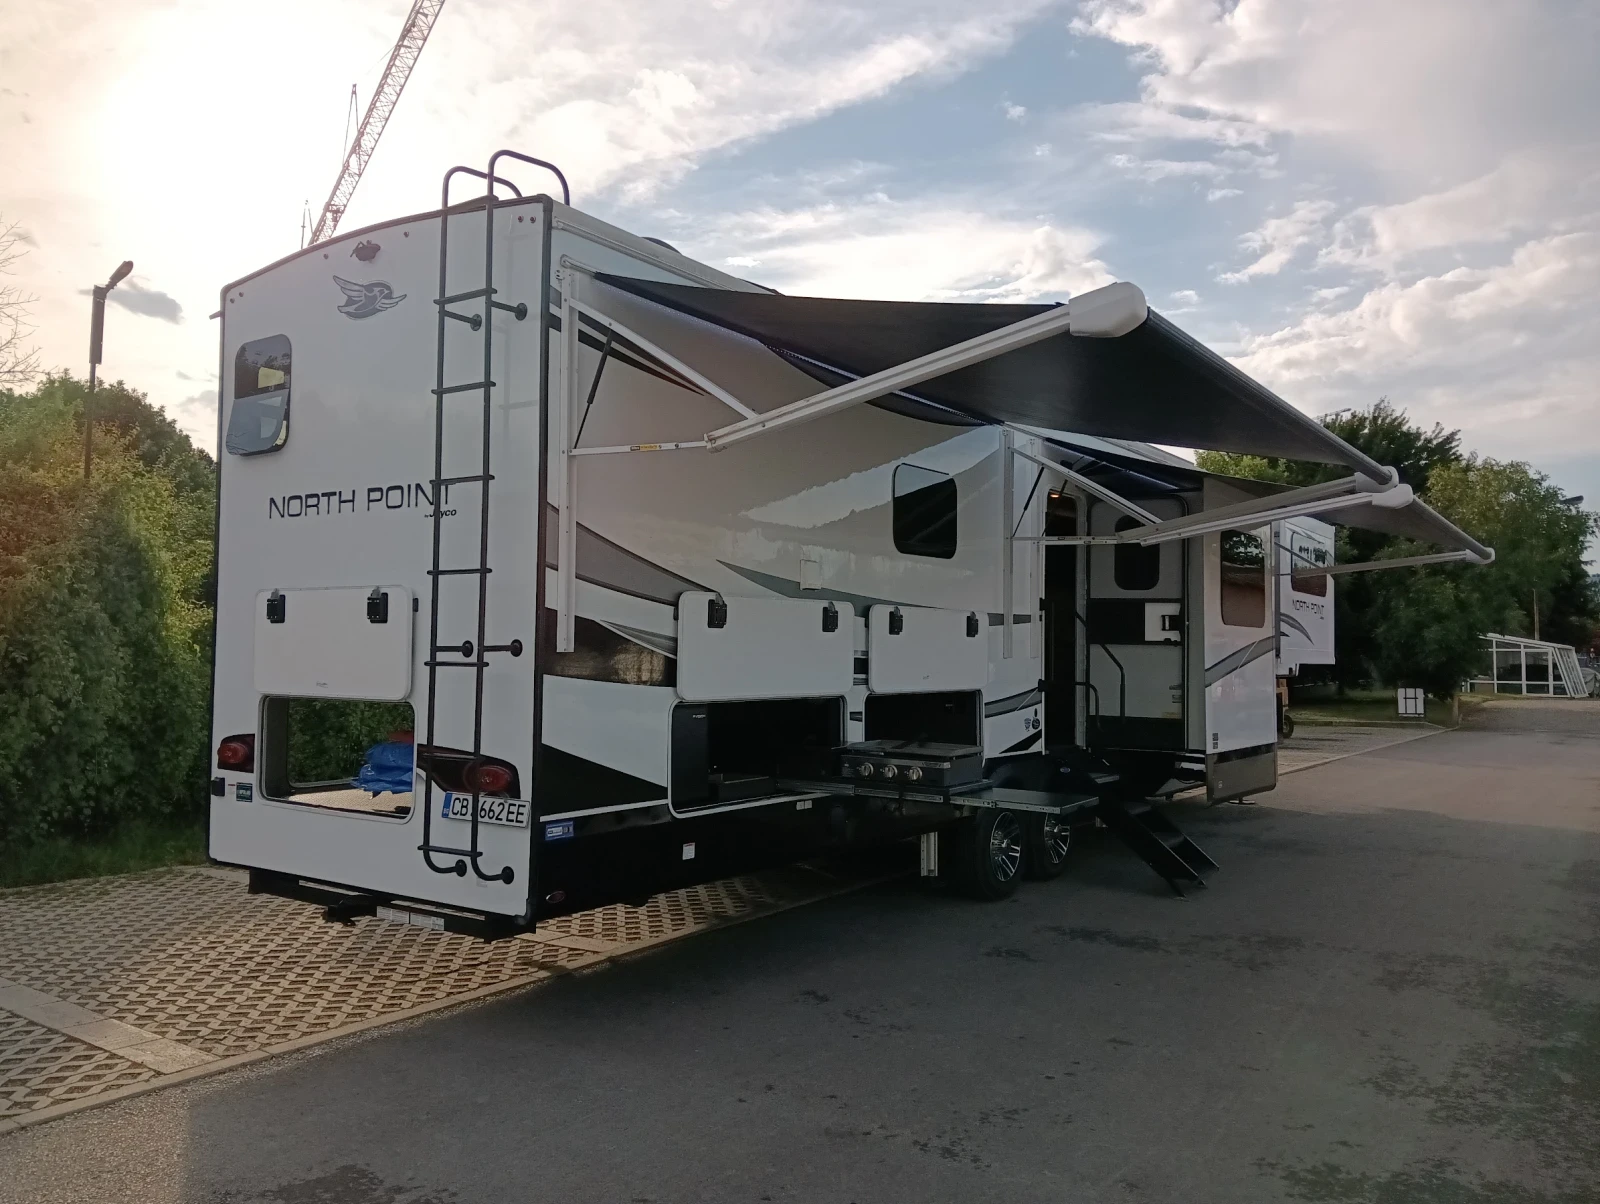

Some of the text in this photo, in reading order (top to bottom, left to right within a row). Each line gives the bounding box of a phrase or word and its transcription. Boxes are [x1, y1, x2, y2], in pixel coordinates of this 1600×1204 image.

[269, 489, 356, 519] NORTH
[429, 509, 457, 519] Jyco
[1292, 599, 1310, 612] NORTH
